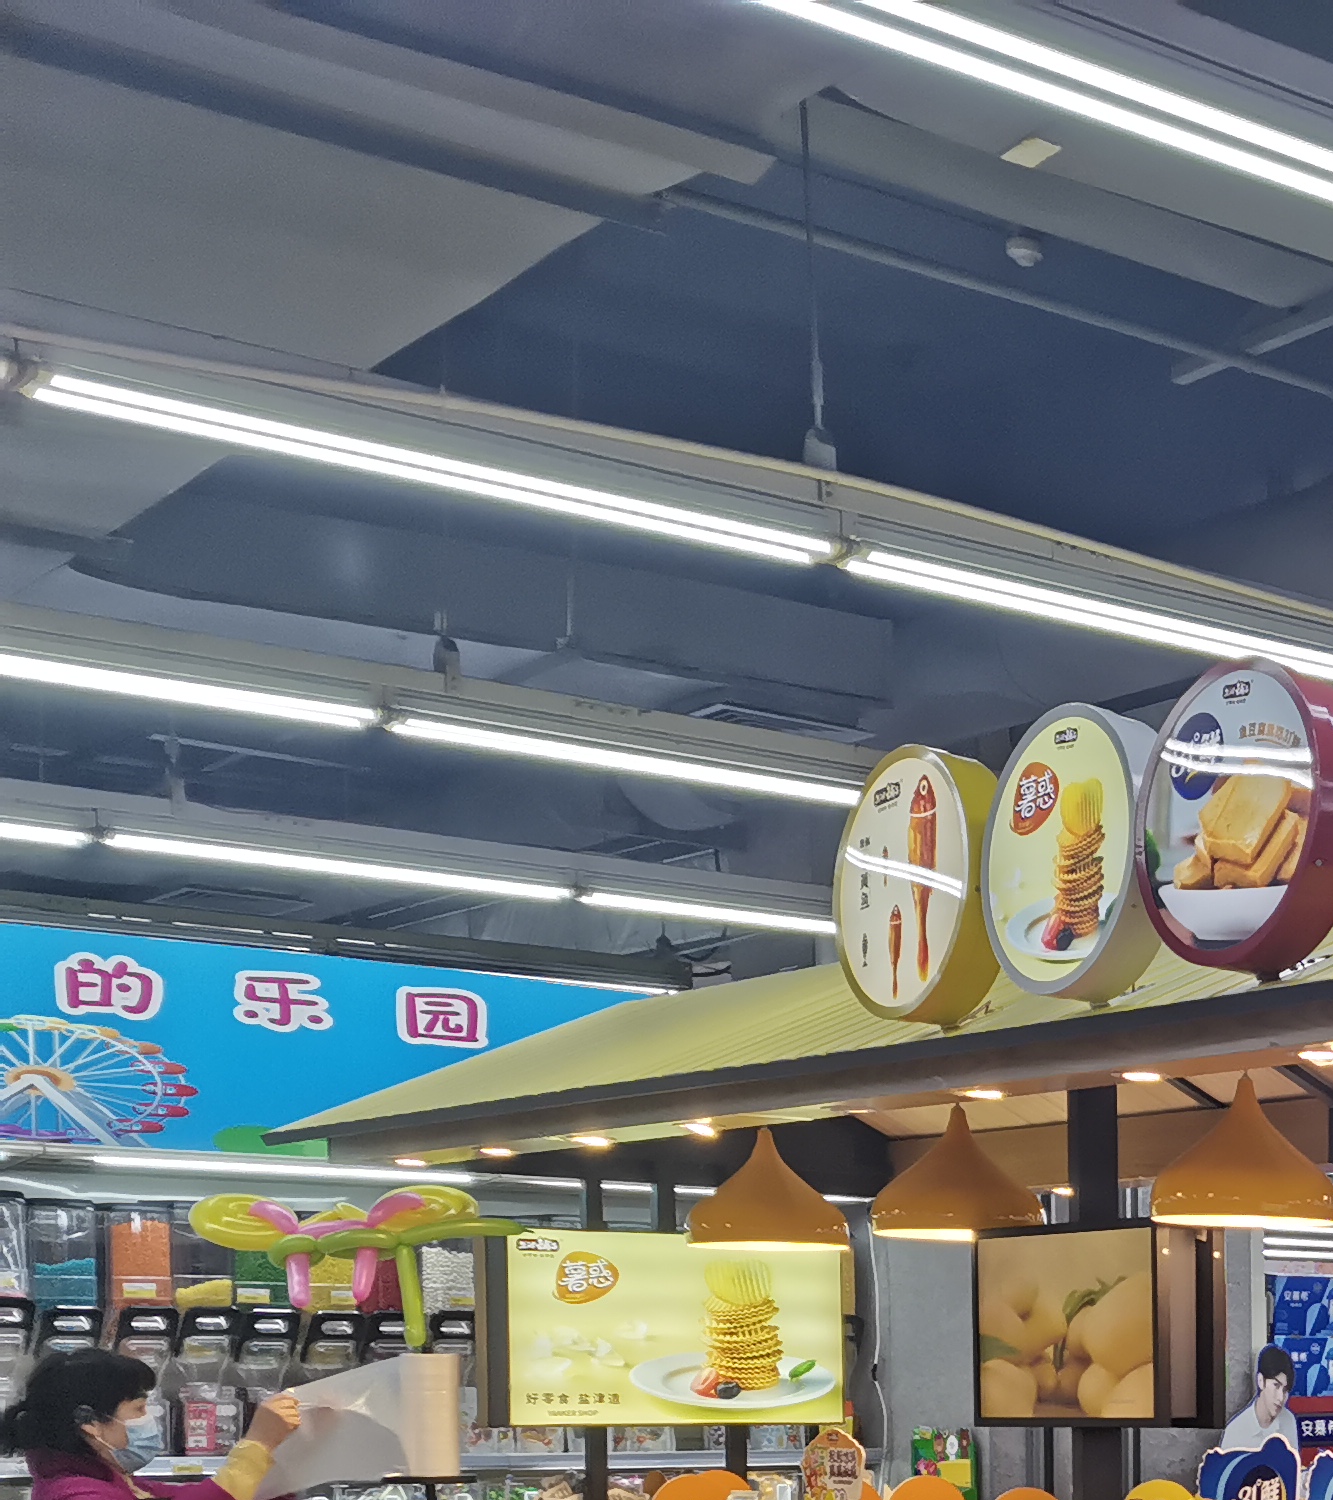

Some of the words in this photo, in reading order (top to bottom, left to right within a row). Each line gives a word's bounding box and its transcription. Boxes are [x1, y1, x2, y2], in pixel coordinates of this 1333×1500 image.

[1017, 768, 1056, 819] 薯惑
[60, 956, 482, 1045] 的乐园
[560, 1259, 613, 1293] 薯惑
